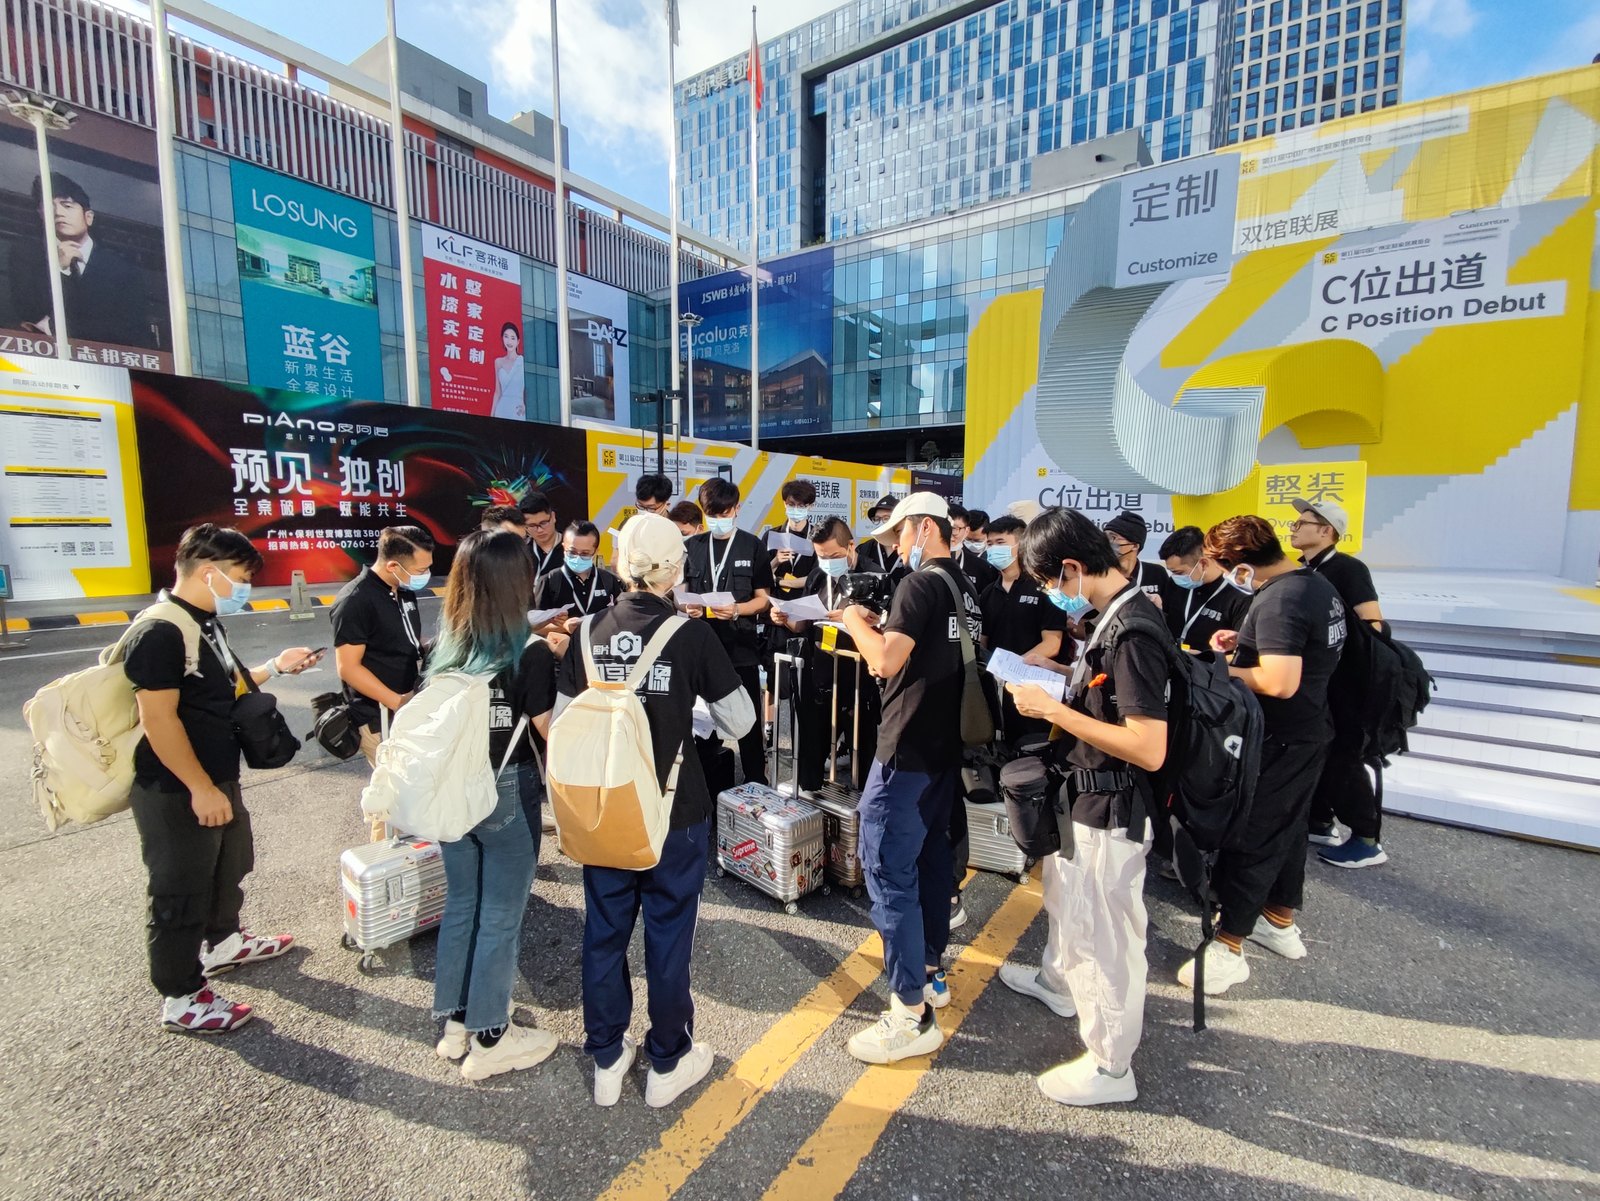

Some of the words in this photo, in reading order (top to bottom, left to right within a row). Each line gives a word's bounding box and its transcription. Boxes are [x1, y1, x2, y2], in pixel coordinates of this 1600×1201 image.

[1130, 169, 1218, 227] 定制
[252, 188, 358, 239] LOSUNG
[1241, 209, 1338, 246] 双馆联展
[437, 236, 473, 257] KLF
[475, 249, 509, 271] 客来福
[1128, 252, 1218, 275] Customize
[1322, 252, 1487, 305] C位出道
[701, 288, 728, 304] JSWB
[464, 278, 485, 365] 整家定制
[1321, 316, 1338, 333] C
[1347, 305, 1453, 330] Position
[1463, 292, 1546, 317] Debut
[76, 346, 160, 371] 志邦家居
[281, 324, 351, 366] 蓝谷
[284, 360, 353, 384] 新贵生活
[286, 378, 355, 399] 全案设计
[338, 422, 389, 437] 皮阿诺
[1039, 485, 1144, 512] C位出道
[1265, 472, 1345, 505] 整装
[233, 498, 316, 517] 全案破圈
[339, 501, 407, 518] 赋能共生
[731, 840, 757, 859] Supreme
